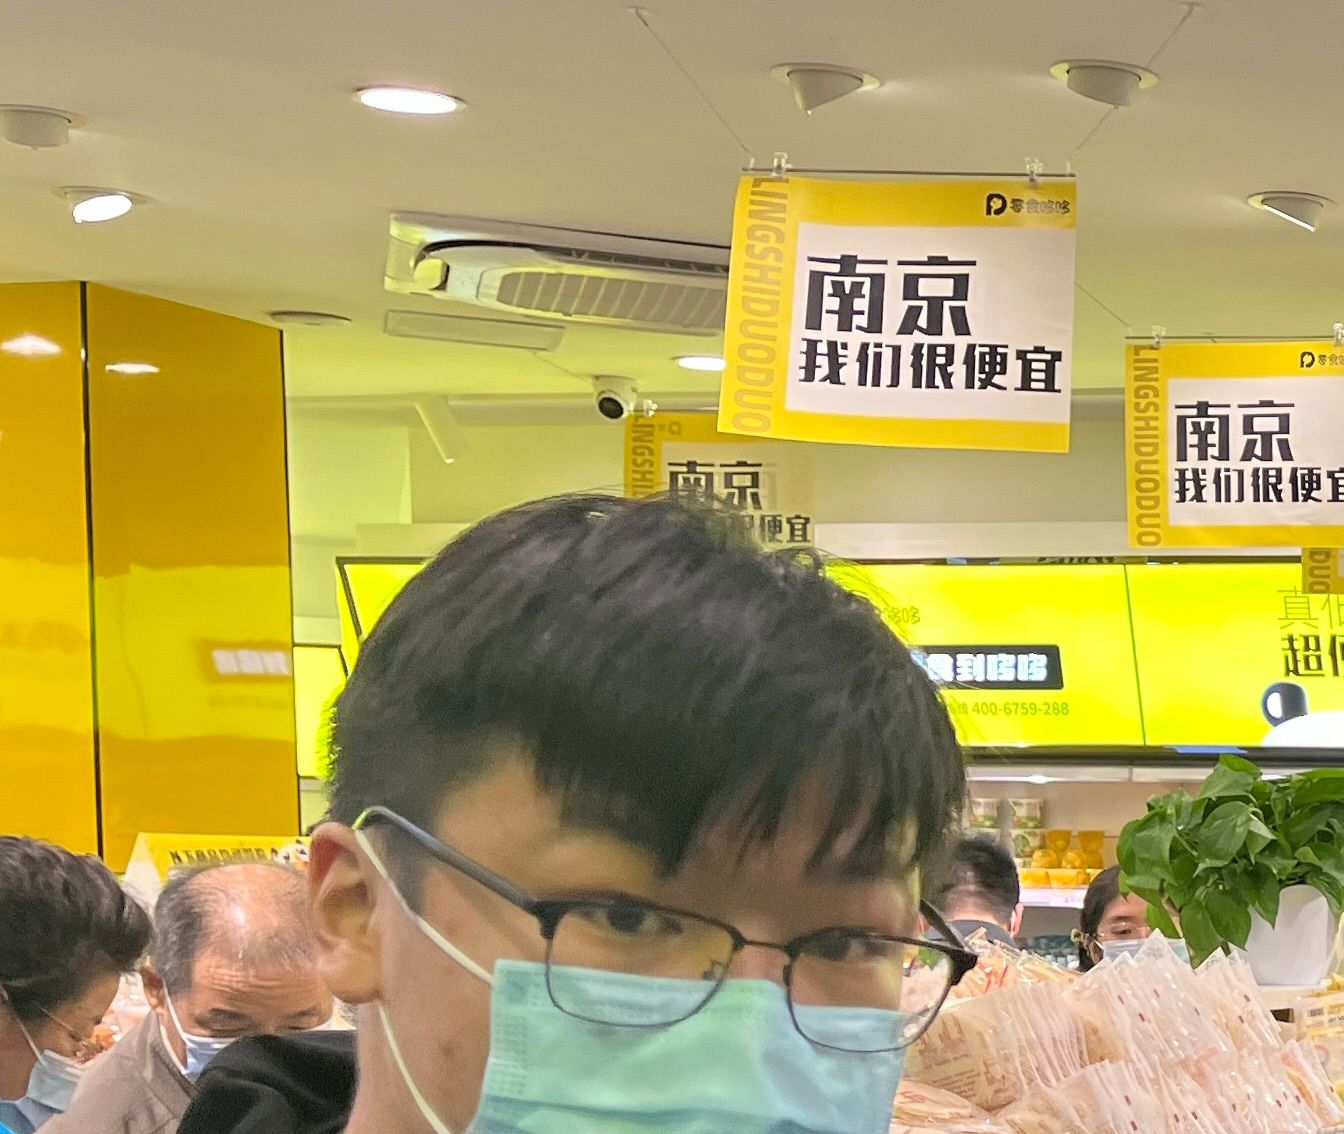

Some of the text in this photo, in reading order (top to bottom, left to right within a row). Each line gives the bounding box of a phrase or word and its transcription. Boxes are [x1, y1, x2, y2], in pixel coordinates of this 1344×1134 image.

[729, 177, 790, 434] LINGSHIDUODUO
[804, 254, 977, 337] 南京
[798, 337, 1063, 394] 我们很便宜
[1131, 345, 1163, 547] LINGSHIDUODUO
[1174, 399, 1296, 463] 南京
[912, 650, 1048, 683] 食到哆哆
[972, 701, 1070, 716] 400-6759-288
